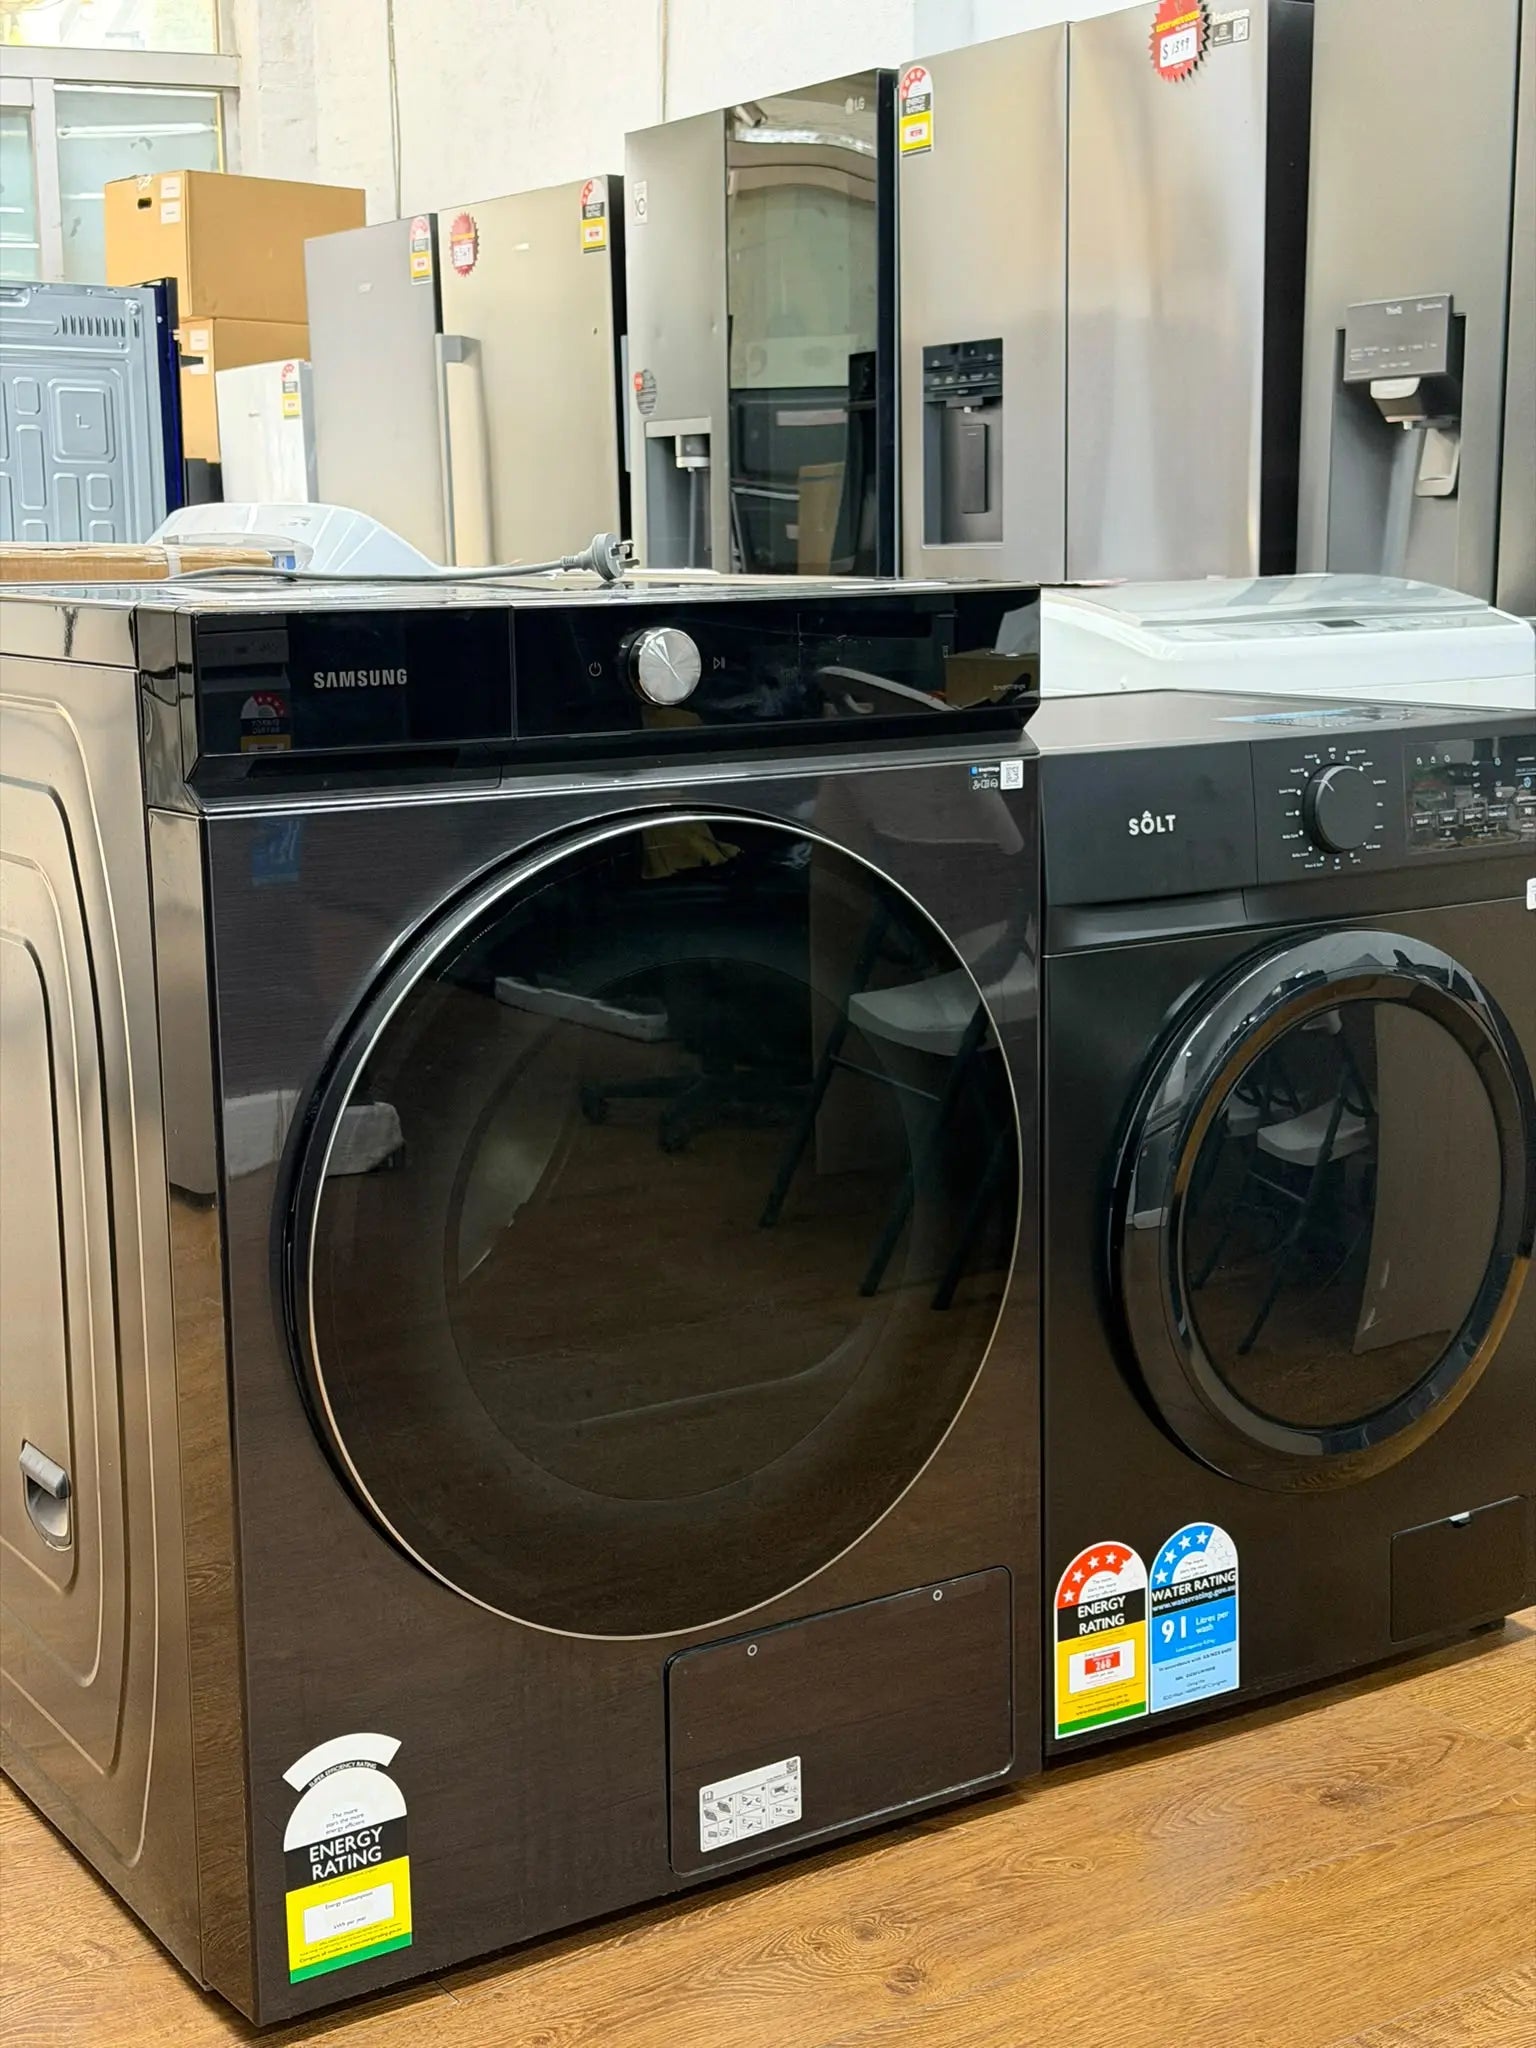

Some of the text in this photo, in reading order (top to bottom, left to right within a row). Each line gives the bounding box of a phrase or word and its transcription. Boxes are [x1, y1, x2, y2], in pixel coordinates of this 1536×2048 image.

[855, 97, 865, 110] LG
[313, 668, 408, 689] SAMSUNG
[1151, 1571, 1236, 1602] WATER RATING
[1077, 1595, 1126, 1619] ENERGY
[1216, 1611, 1229, 1622] per
[1079, 1613, 1125, 1635] RATING
[1195, 1624, 1214, 1634] wash
[309, 1761, 377, 1788] SUPER EFFICIENCY RATING
[309, 1826, 383, 1863] ENERGY
[312, 1846, 382, 1881] RATING
